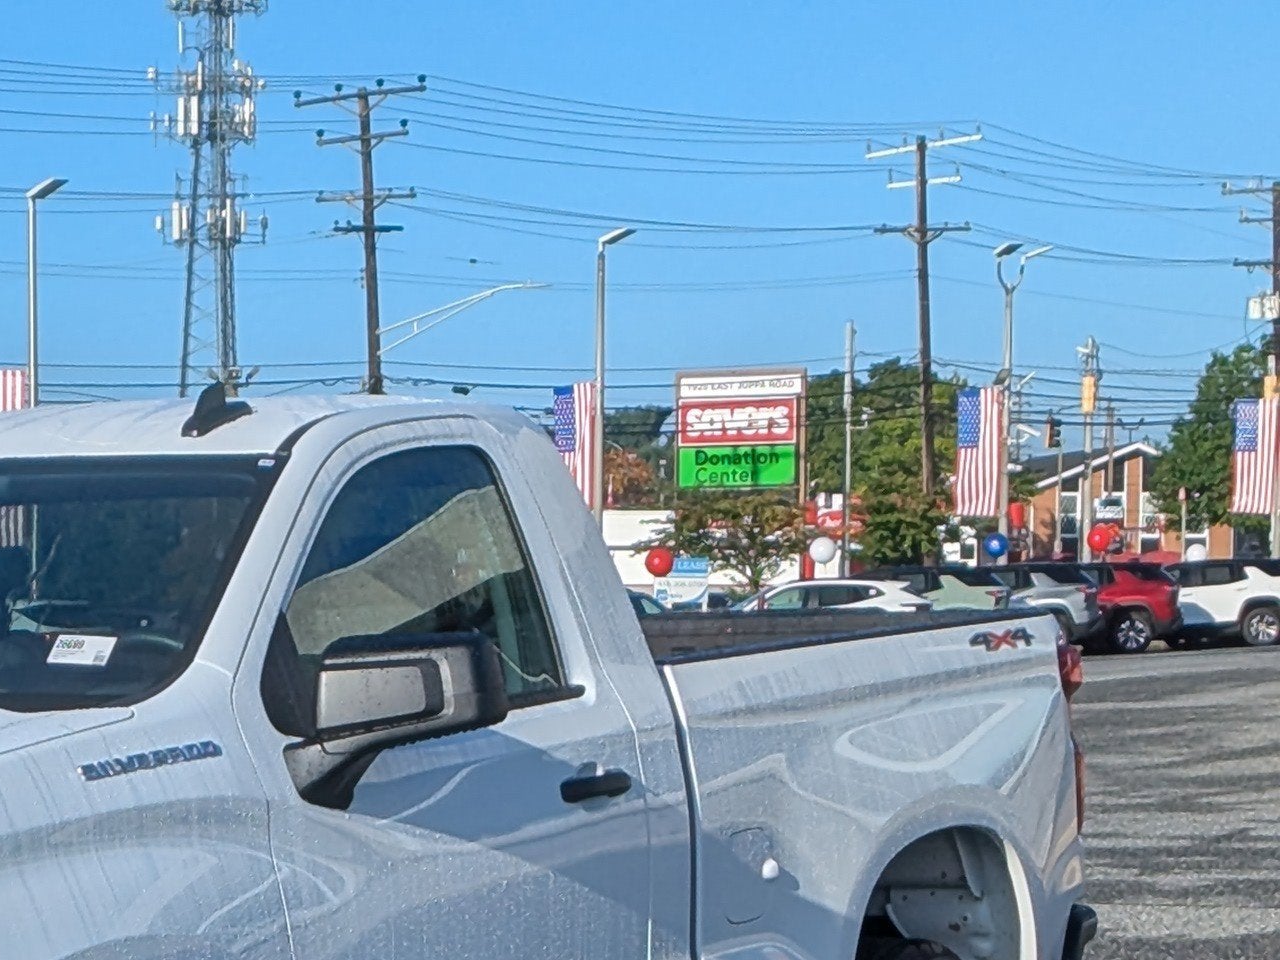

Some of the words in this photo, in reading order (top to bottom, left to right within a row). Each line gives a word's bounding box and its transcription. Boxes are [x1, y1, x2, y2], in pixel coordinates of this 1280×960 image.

[769, 379, 795, 389] ROAD
[694, 449, 780, 466] Donation
[695, 467, 754, 483] Center
